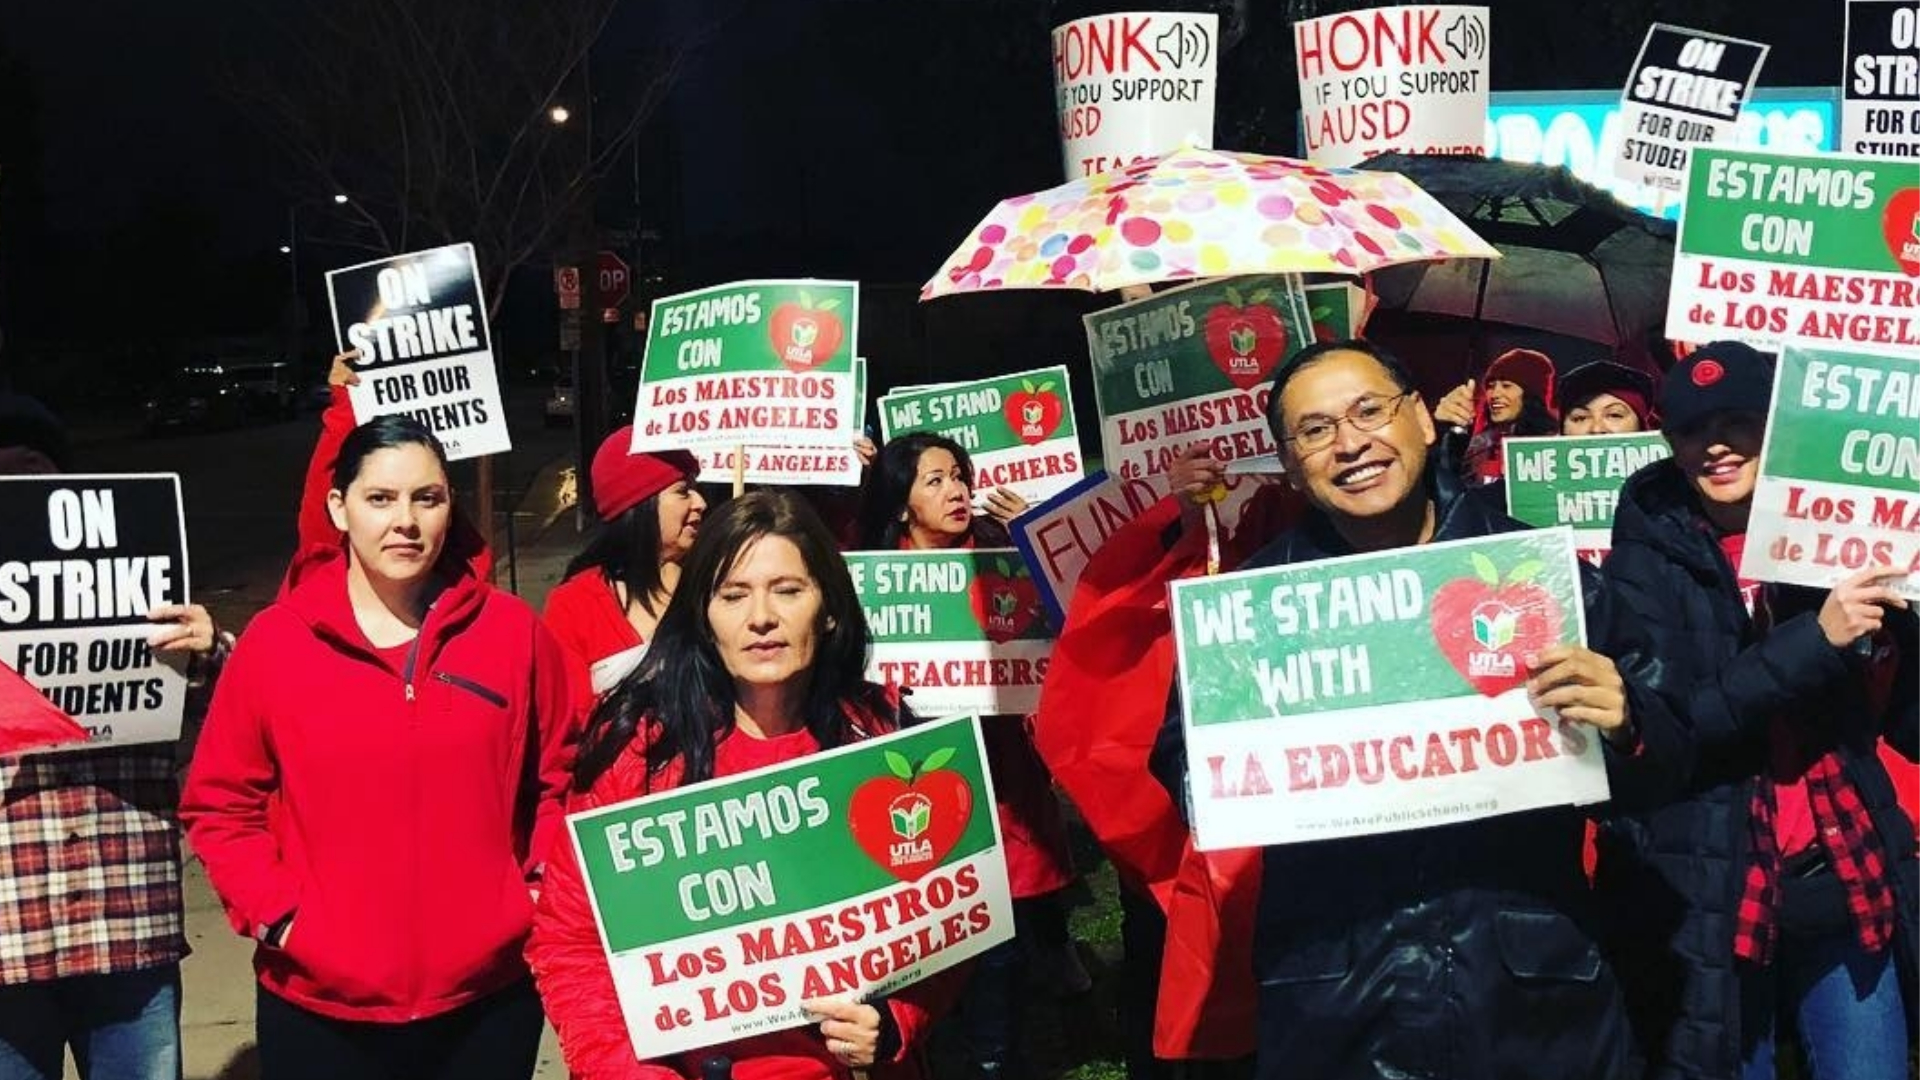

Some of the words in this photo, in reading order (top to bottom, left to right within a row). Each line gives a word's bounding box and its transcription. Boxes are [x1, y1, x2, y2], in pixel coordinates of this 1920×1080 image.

[1301, 9, 1446, 80] HONK
[1891, 7, 1920, 49] O
[1053, 17, 1161, 82] HONK
[1678, 38, 1725, 72] ON
[1071, 84, 1101, 104] YOU
[1112, 78, 1204, 102] SUPPORT
[1316, 82, 1331, 105] IF
[1342, 75, 1387, 101] YOU
[1401, 70, 1479, 96] SUPPORT
[1634, 66, 1743, 117] STRIKE
[1854, 54, 1920, 96] STR
[1061, 106, 1101, 140] USD
[1306, 100, 1410, 150] LAUSD
[1638, 112, 1673, 138] FOR
[1676, 120, 1715, 142] OUR
[1865, 109, 1904, 134] FOR
[1707, 158, 1876, 209] ESTAMOS
[1741, 213, 1814, 256] CON
[377, 263, 432, 309] ON
[1698, 262, 1756, 293] Los
[1767, 270, 1920, 309] MAESTR
[348, 304, 479, 366] STRIKE
[661, 293, 761, 337] ESTAMOS
[1100, 300, 1195, 356] ESTAMOS
[1688, 303, 1716, 325] de
[1723, 302, 1789, 333] LOS
[1797, 310, 1920, 346] ANGEL
[677, 337, 723, 370] CON
[1229, 358, 1258, 369] UTLA
[373, 370, 418, 405] FOR
[422, 365, 470, 394] OUR
[652, 386, 687, 407] Los
[696, 377, 835, 402] MAESTROS
[1134, 359, 1174, 398] CON
[1801, 360, 1920, 418] ESTA
[399, 398, 488, 432] DENTS
[645, 420, 662, 437] de
[668, 409, 710, 433] LOS
[718, 406, 838, 430] ANGELES
[891, 401, 922, 429] WE
[928, 388, 1001, 422] STAND
[939, 425, 979, 450] TH
[1118, 417, 1158, 445] Los
[757, 455, 849, 473] ANGELES
[972, 452, 1077, 490] ACHERS
[1120, 459, 1141, 480] de
[1187, 429, 1274, 462] GEL
[1516, 448, 1557, 481] WE
[1567, 444, 1669, 480] STAND
[1841, 429, 1920, 481] CON
[48, 488, 118, 550] ON
[1785, 486, 1856, 524] Los
[1770, 536, 1803, 562] de
[1812, 533, 1893, 570] LOS
[0, 555, 173, 623] STRIKE
[847, 562, 865, 594] E
[875, 562, 966, 594] STAND
[864, 604, 931, 636] WITH
[1193, 589, 1255, 646] WE
[1271, 568, 1423, 635] STAND
[17, 642, 77, 678] FOR
[88, 638, 152, 672] OUR
[1257, 644, 1371, 710] WITH
[1469, 652, 1515, 669] UTLA
[38, 678, 164, 716] UDENTS
[1207, 752, 1273, 798] LA
[1285, 716, 1588, 793] EDUCATORS
[605, 776, 830, 873] ESTAMOS
[889, 839, 932, 856] UTLA
[678, 860, 777, 921] CON
[645, 945, 727, 987] Los
[737, 863, 981, 966] MAESTROS
[655, 1005, 692, 1032] de
[698, 973, 786, 1022] LOS
[800, 901, 992, 1000] ANGELES
